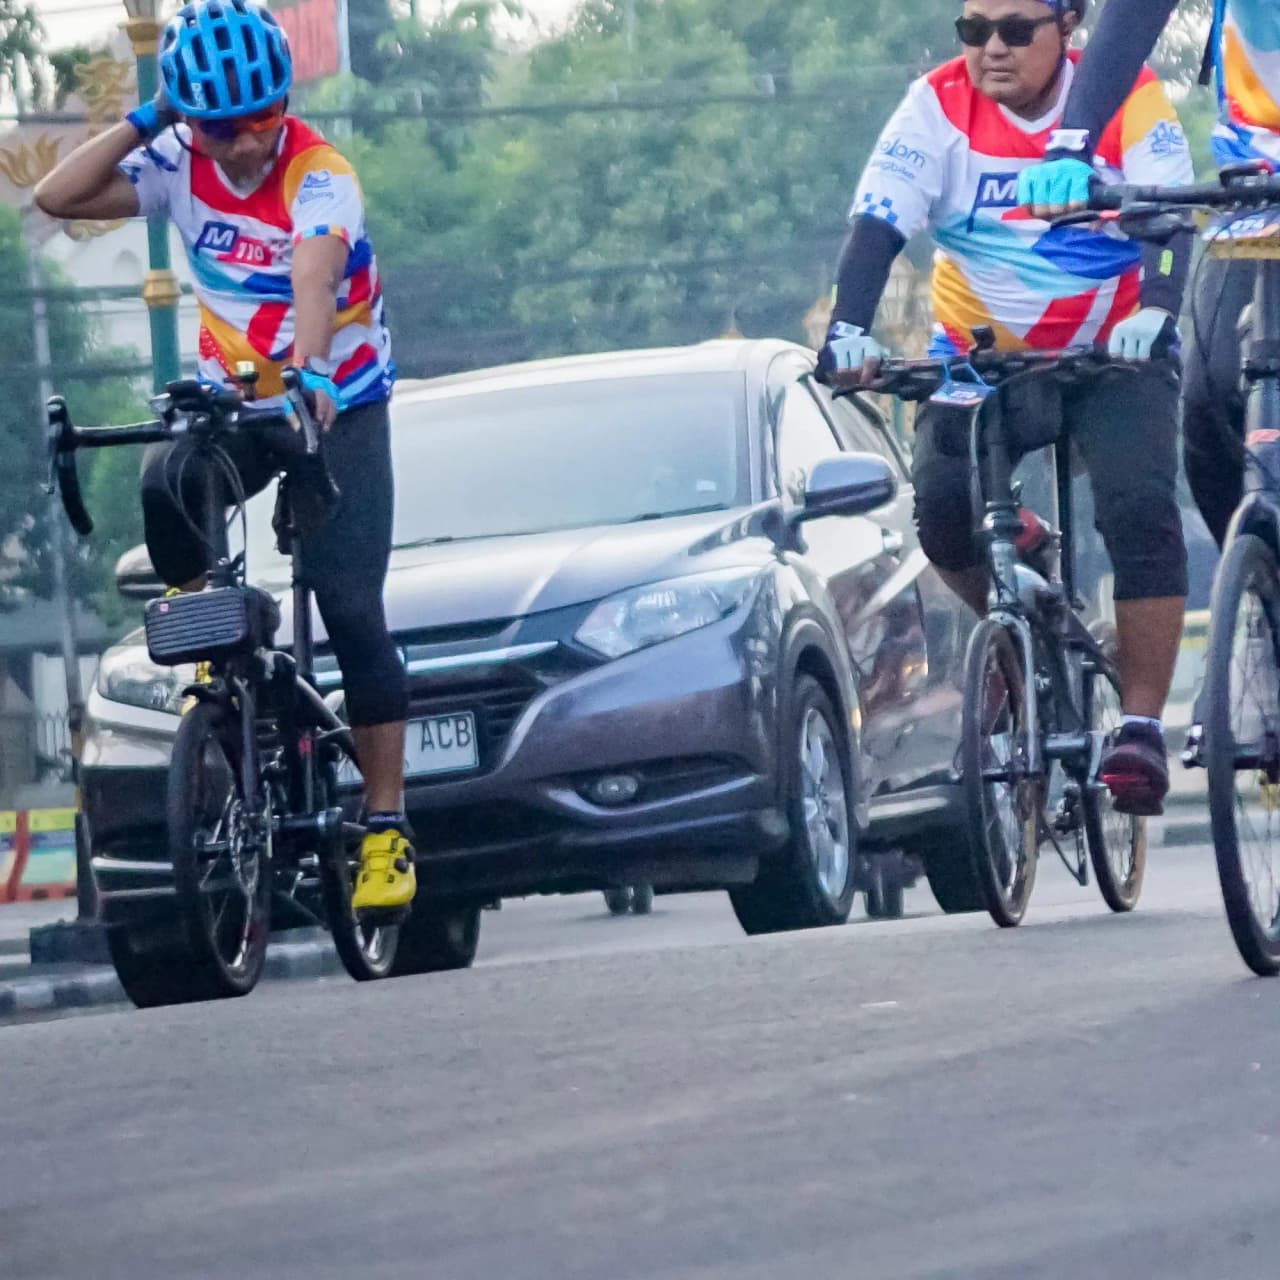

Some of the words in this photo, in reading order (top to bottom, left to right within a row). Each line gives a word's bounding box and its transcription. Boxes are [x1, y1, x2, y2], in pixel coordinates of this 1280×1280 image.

[204, 227, 235, 247] M
[236, 242, 265, 261] 110
[420, 718, 471, 752] ACB
